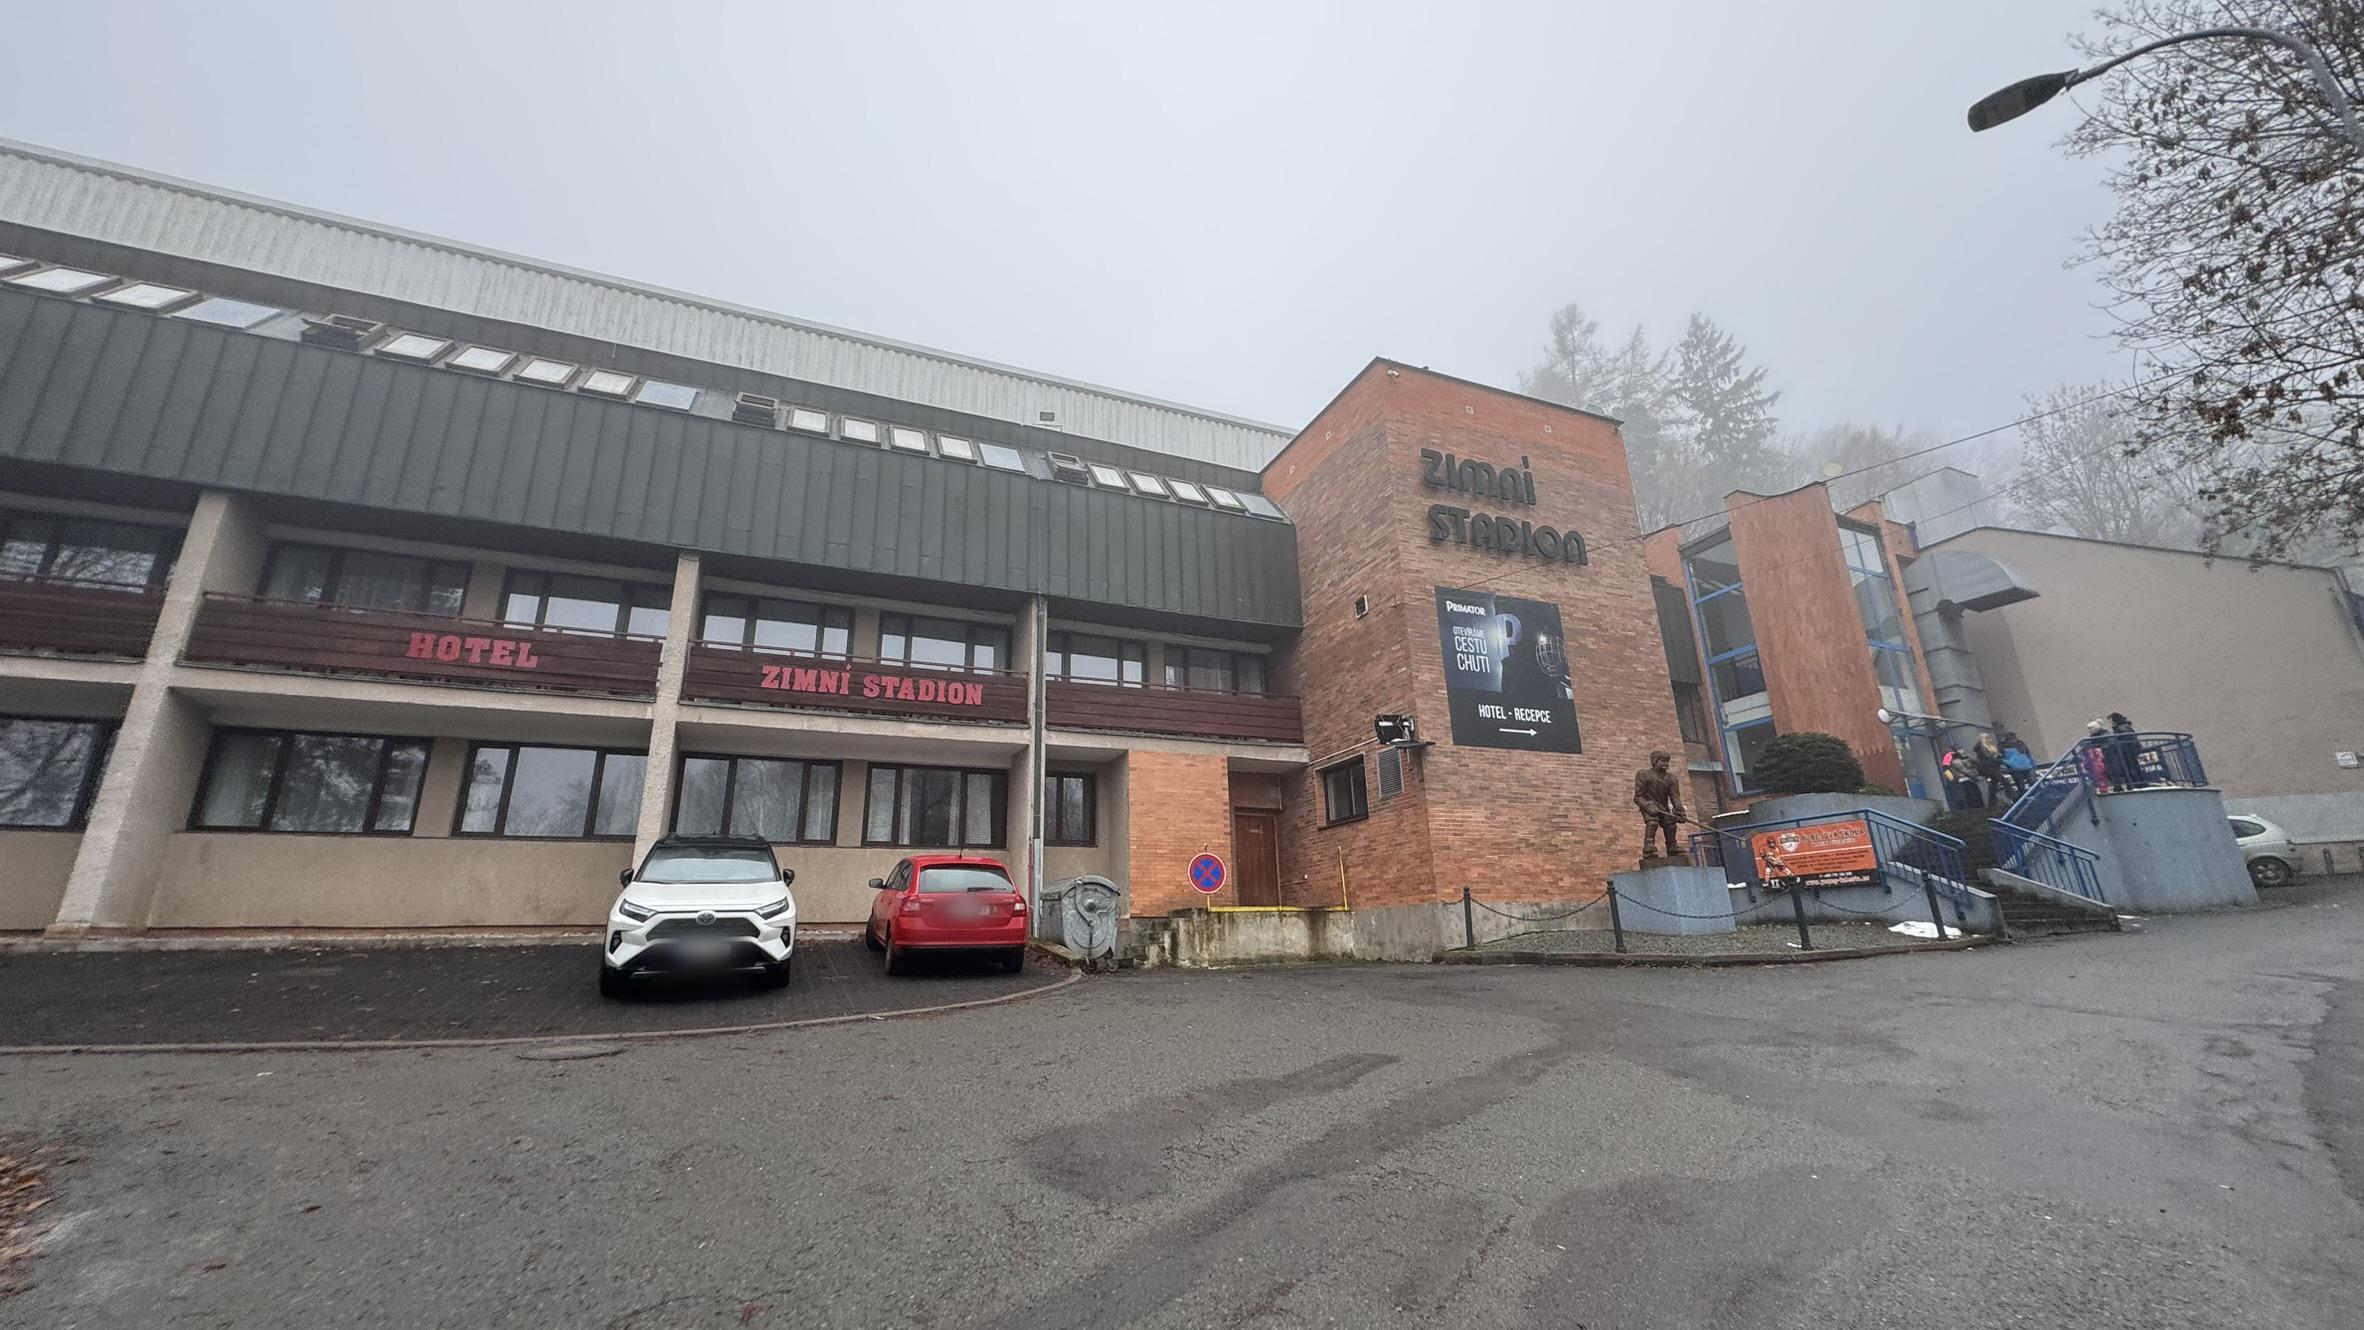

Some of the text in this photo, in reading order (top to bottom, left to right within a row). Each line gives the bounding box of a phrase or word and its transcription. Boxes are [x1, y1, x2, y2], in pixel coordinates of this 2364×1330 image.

[405, 632, 539, 669] HOTEL
[1454, 636, 1488, 655] CESTU
[1456, 653, 1491, 673] CHUTI
[761, 663, 984, 706] ZIMNÍ STADION
[1478, 704, 1507, 720] HOTEL
[1514, 707, 1551, 724] RECEPCE
